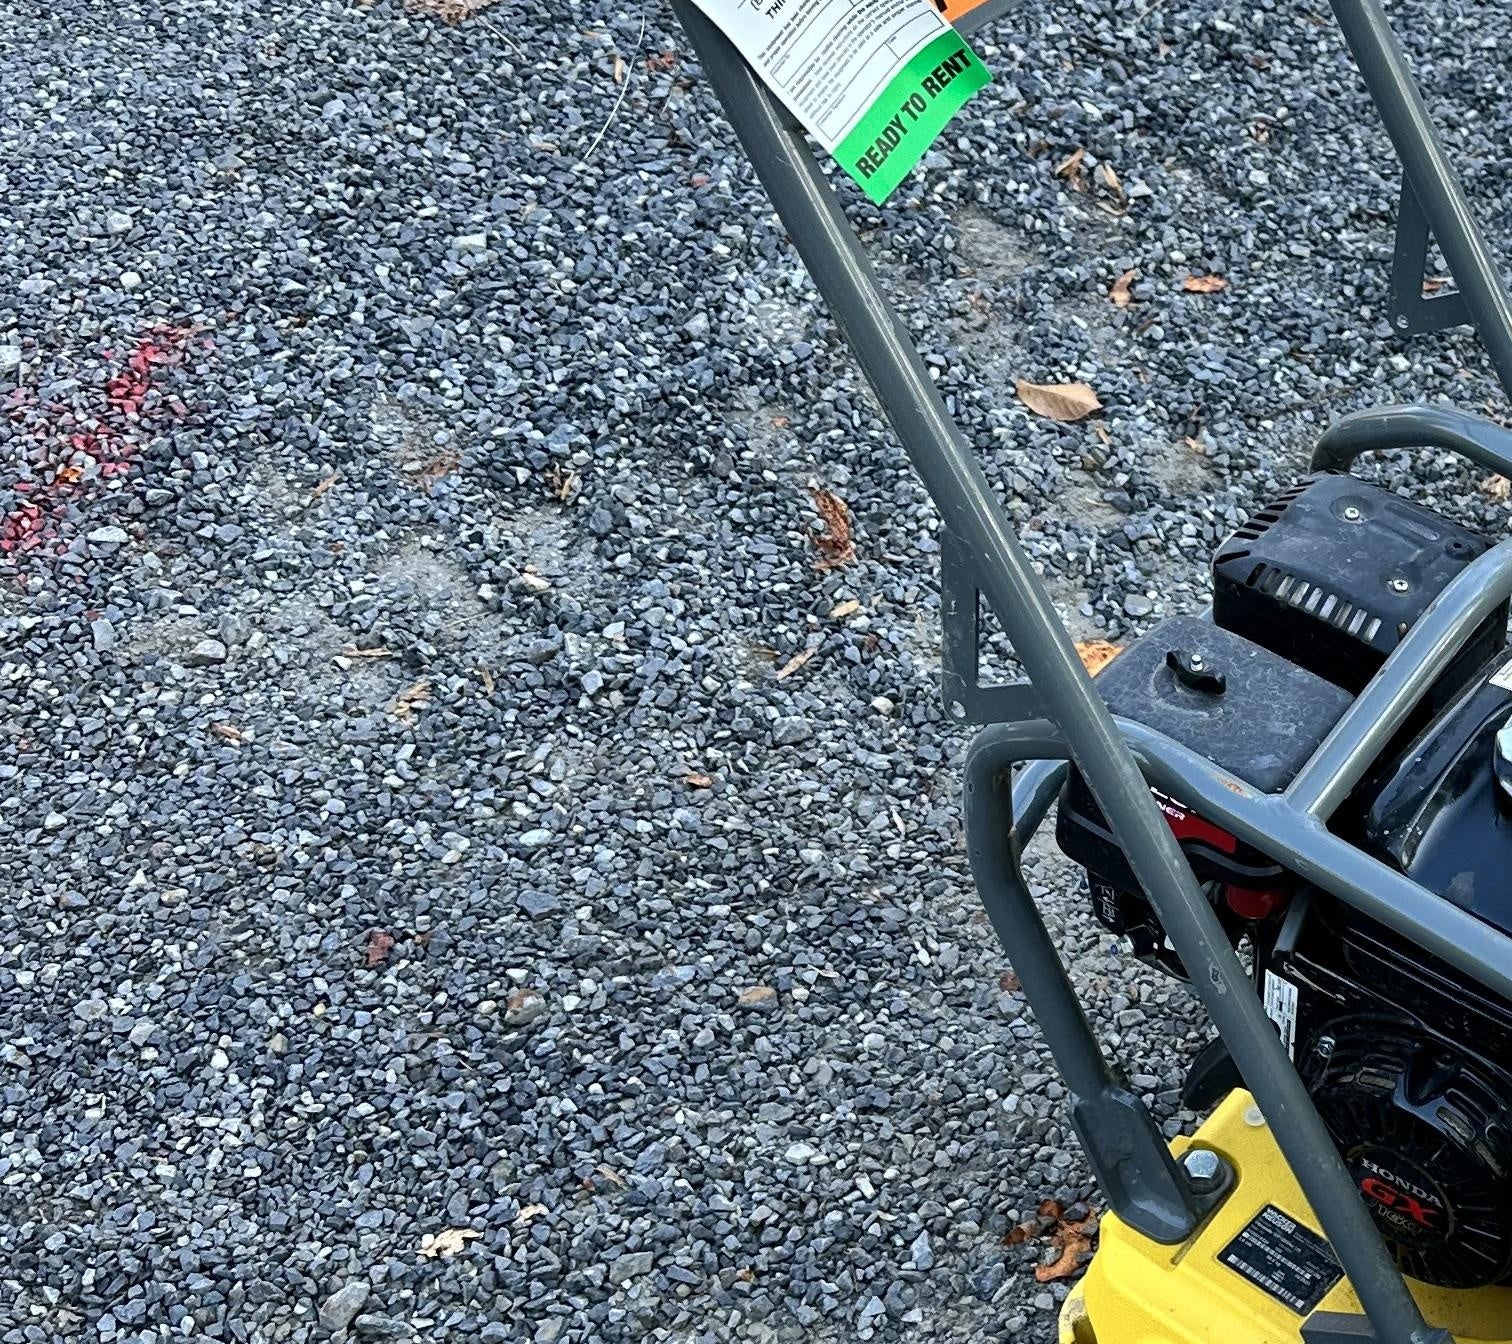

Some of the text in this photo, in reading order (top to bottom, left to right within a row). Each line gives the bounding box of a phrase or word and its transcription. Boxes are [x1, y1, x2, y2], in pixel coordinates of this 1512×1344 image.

[854, 48, 974, 180] READY TO RENT
[1361, 1157, 1444, 1209] HONDA
[1362, 1178, 1439, 1227] GX
